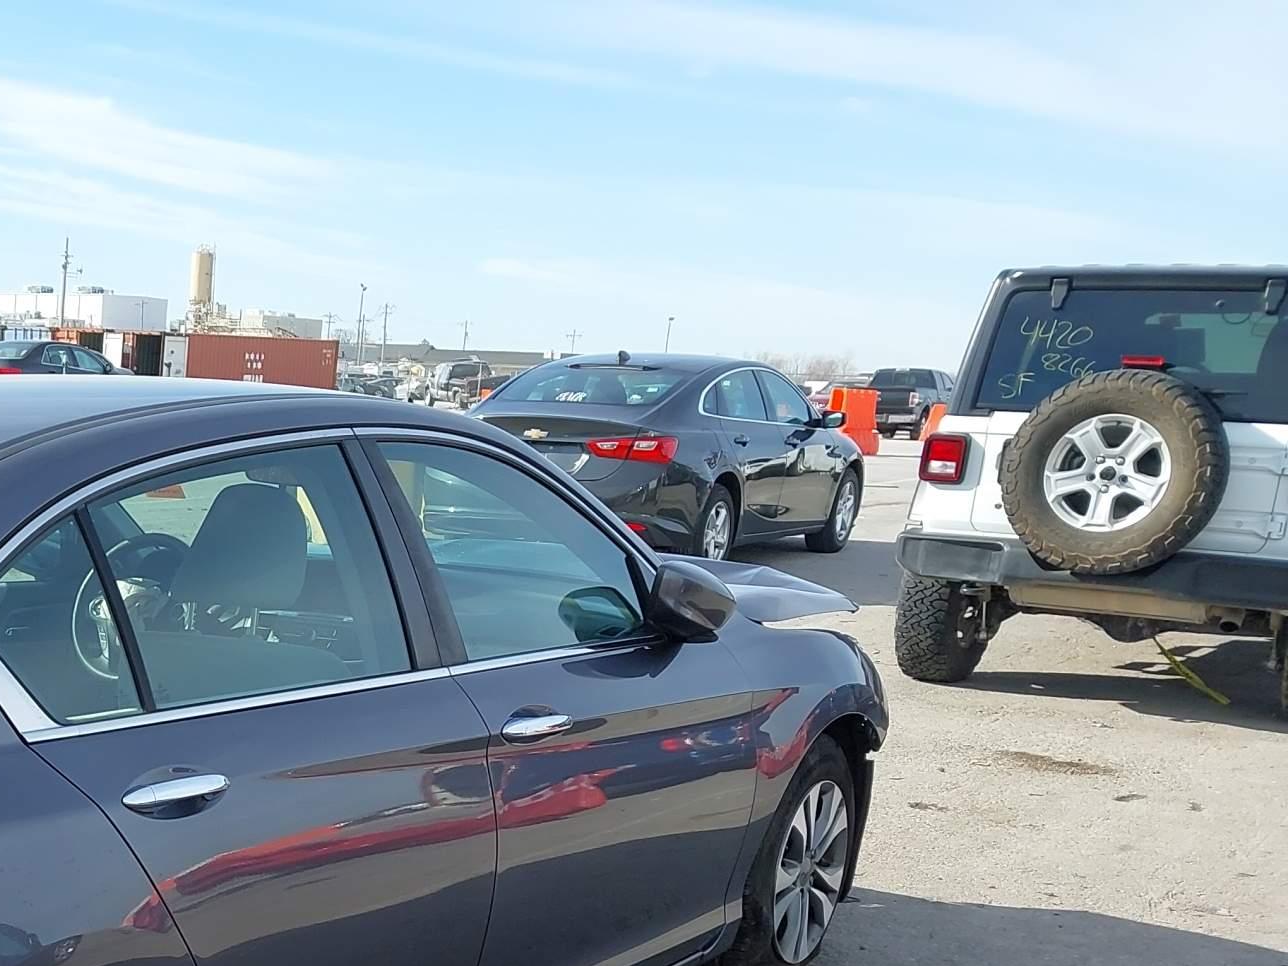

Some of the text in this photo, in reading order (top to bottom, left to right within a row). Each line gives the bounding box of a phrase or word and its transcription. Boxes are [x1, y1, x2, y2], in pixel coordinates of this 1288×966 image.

[1020, 316, 1094, 349] 4420
[1041, 352, 1096, 379] 8266
[998, 372, 1037, 399] SF
